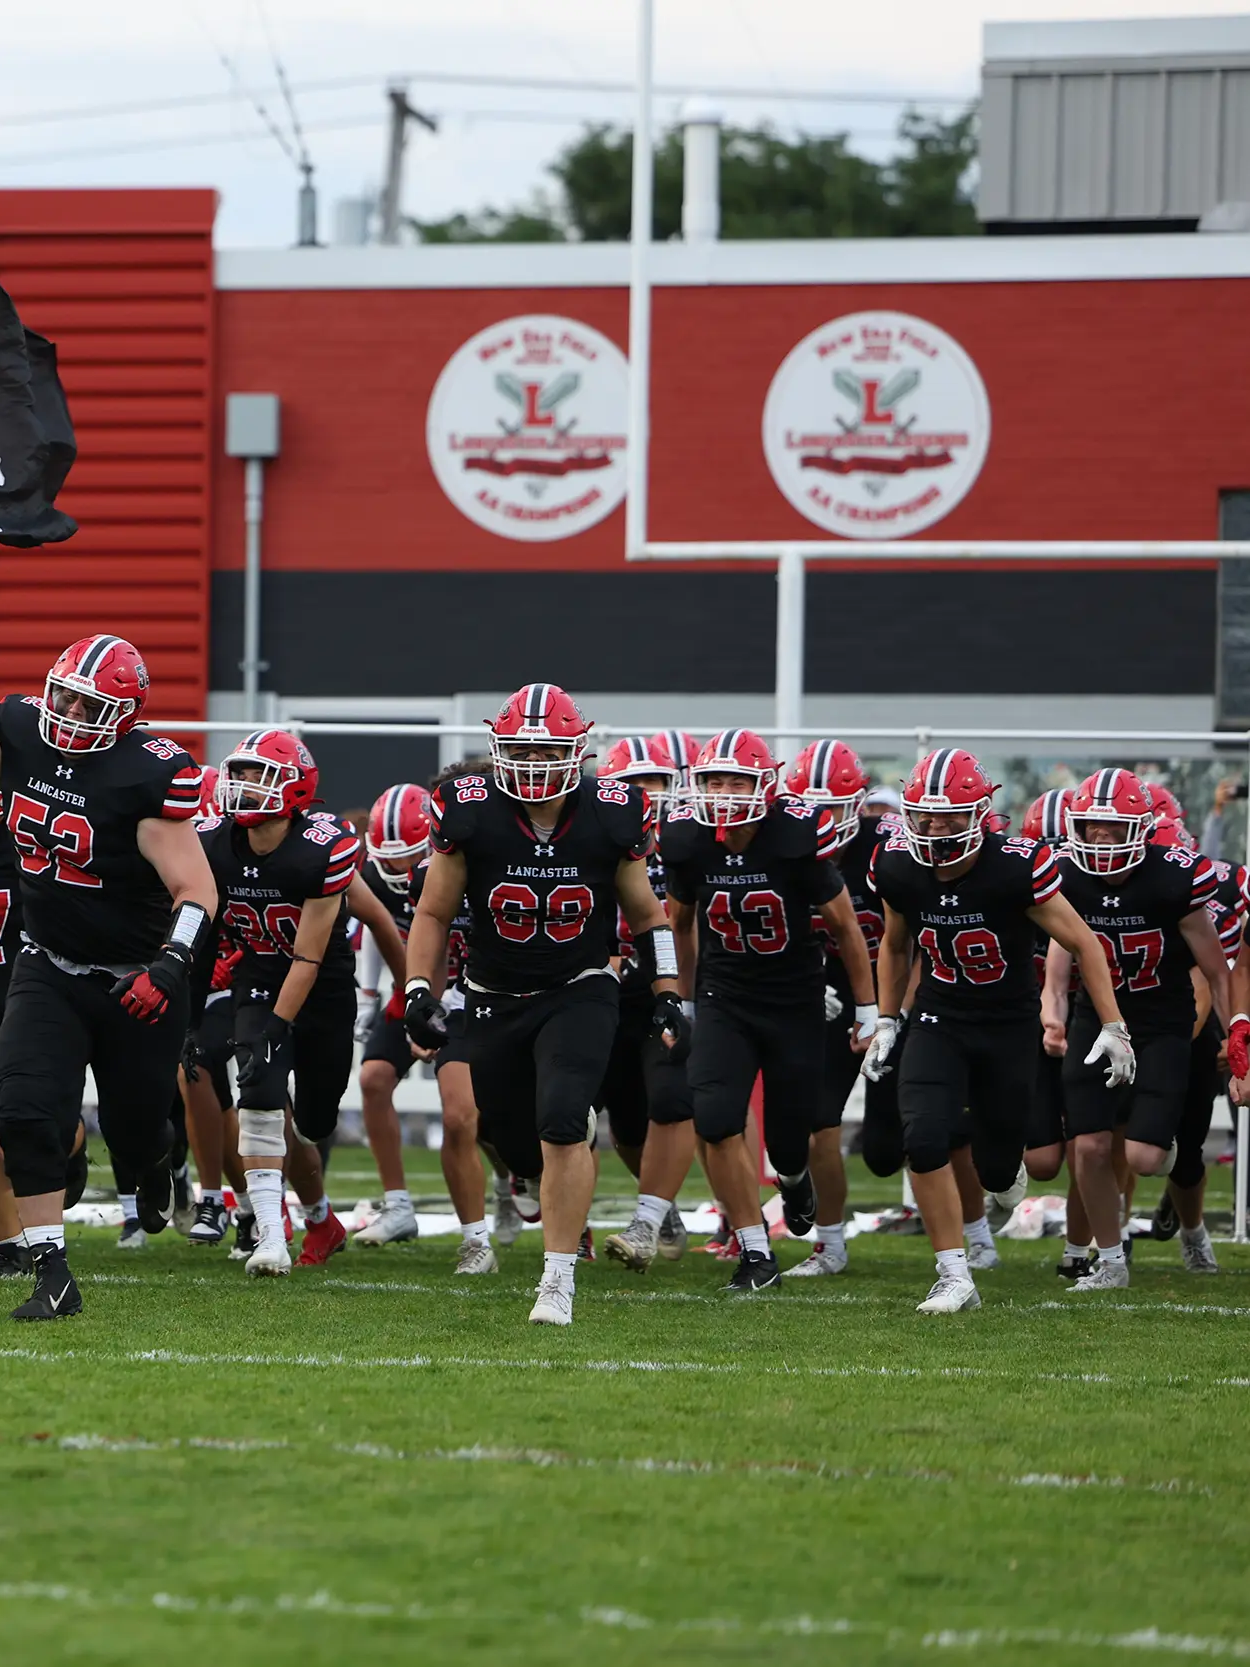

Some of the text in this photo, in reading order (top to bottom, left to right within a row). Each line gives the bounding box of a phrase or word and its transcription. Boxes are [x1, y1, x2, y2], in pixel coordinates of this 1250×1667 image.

[521, 381, 555, 428] L
[861, 378, 895, 425] L
[69, 674, 93, 687] Riddell
[27, 776, 86, 807] LANCASTER
[6, 791, 103, 888] 52
[506, 864, 579, 878] LANCASTER
[705, 873, 768, 885] LANCASTER
[227, 885, 283, 898] LANCASTER
[487, 882, 594, 944] 69
[705, 890, 790, 955] 43
[920, 911, 985, 925] LANCASTER
[1084, 913, 1146, 926] LANCASTER
[222, 899, 303, 960] 20
